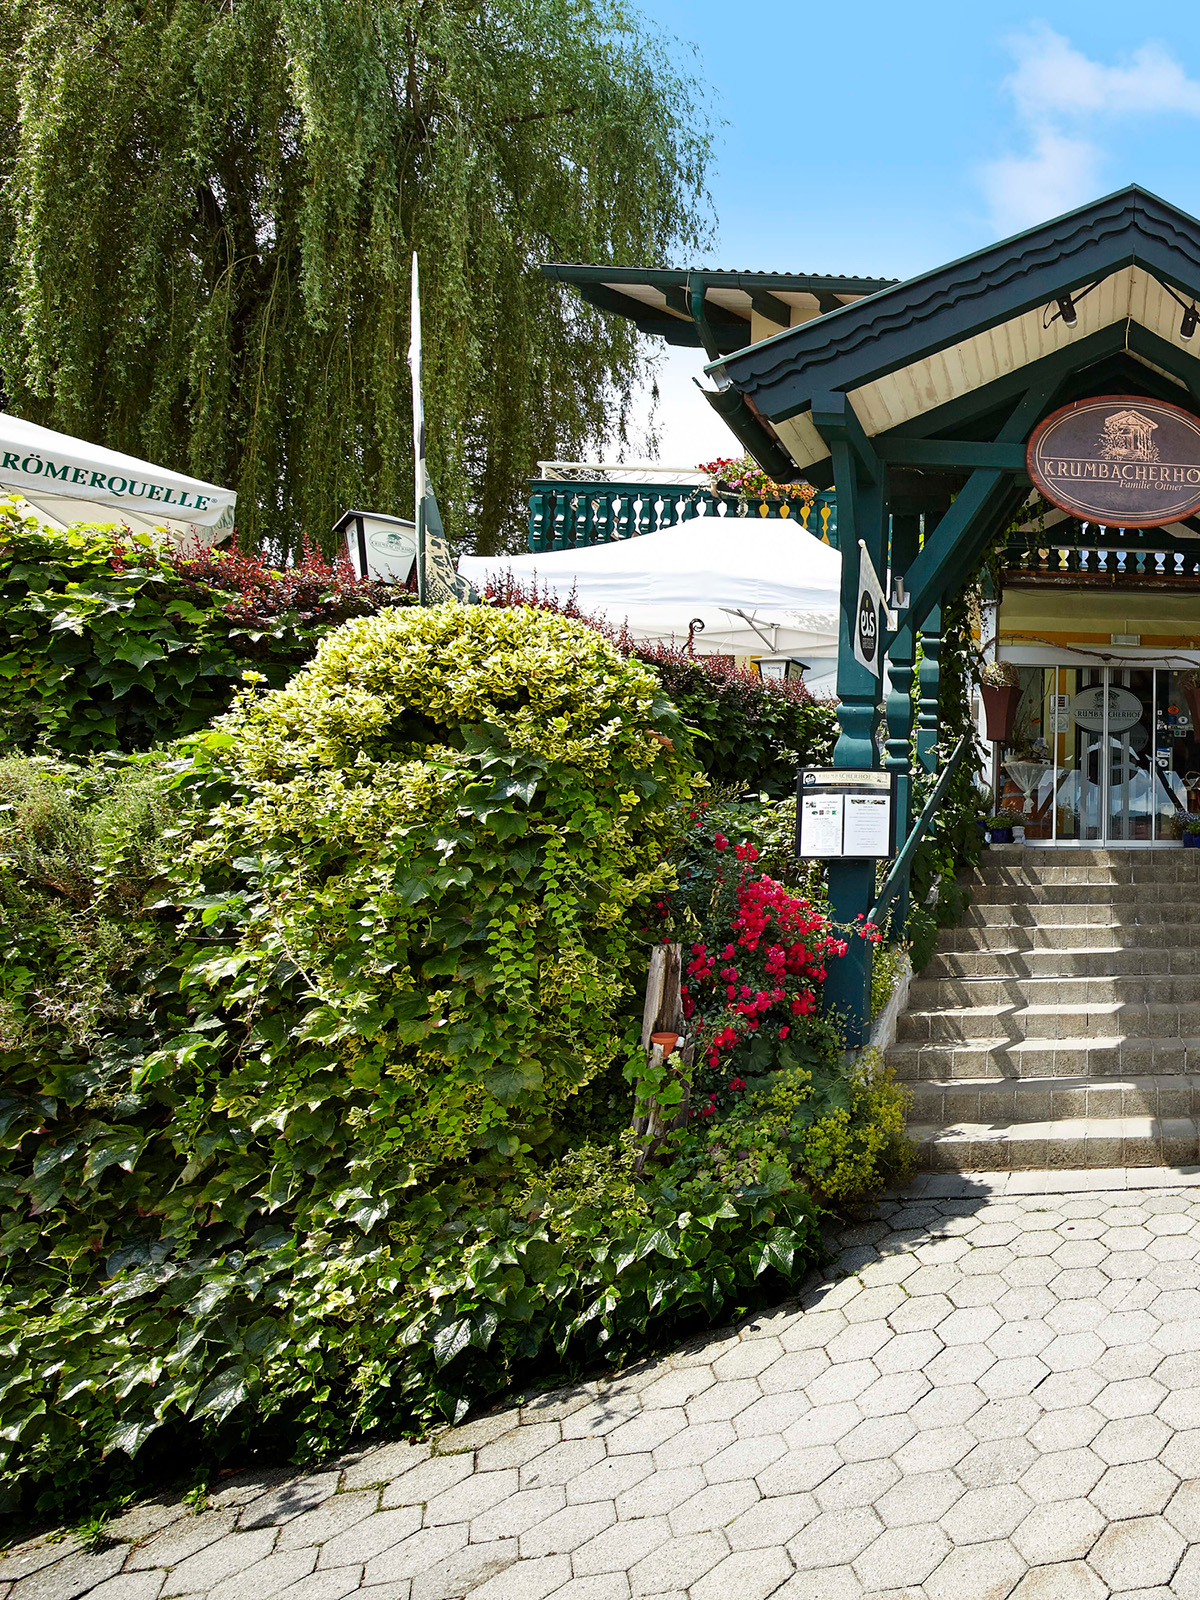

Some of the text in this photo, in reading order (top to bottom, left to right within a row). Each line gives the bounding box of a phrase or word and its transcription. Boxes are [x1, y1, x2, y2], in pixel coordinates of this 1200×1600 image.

[1119, 480, 1183, 491] Familie Ottner
[861, 600, 876, 637] eis
